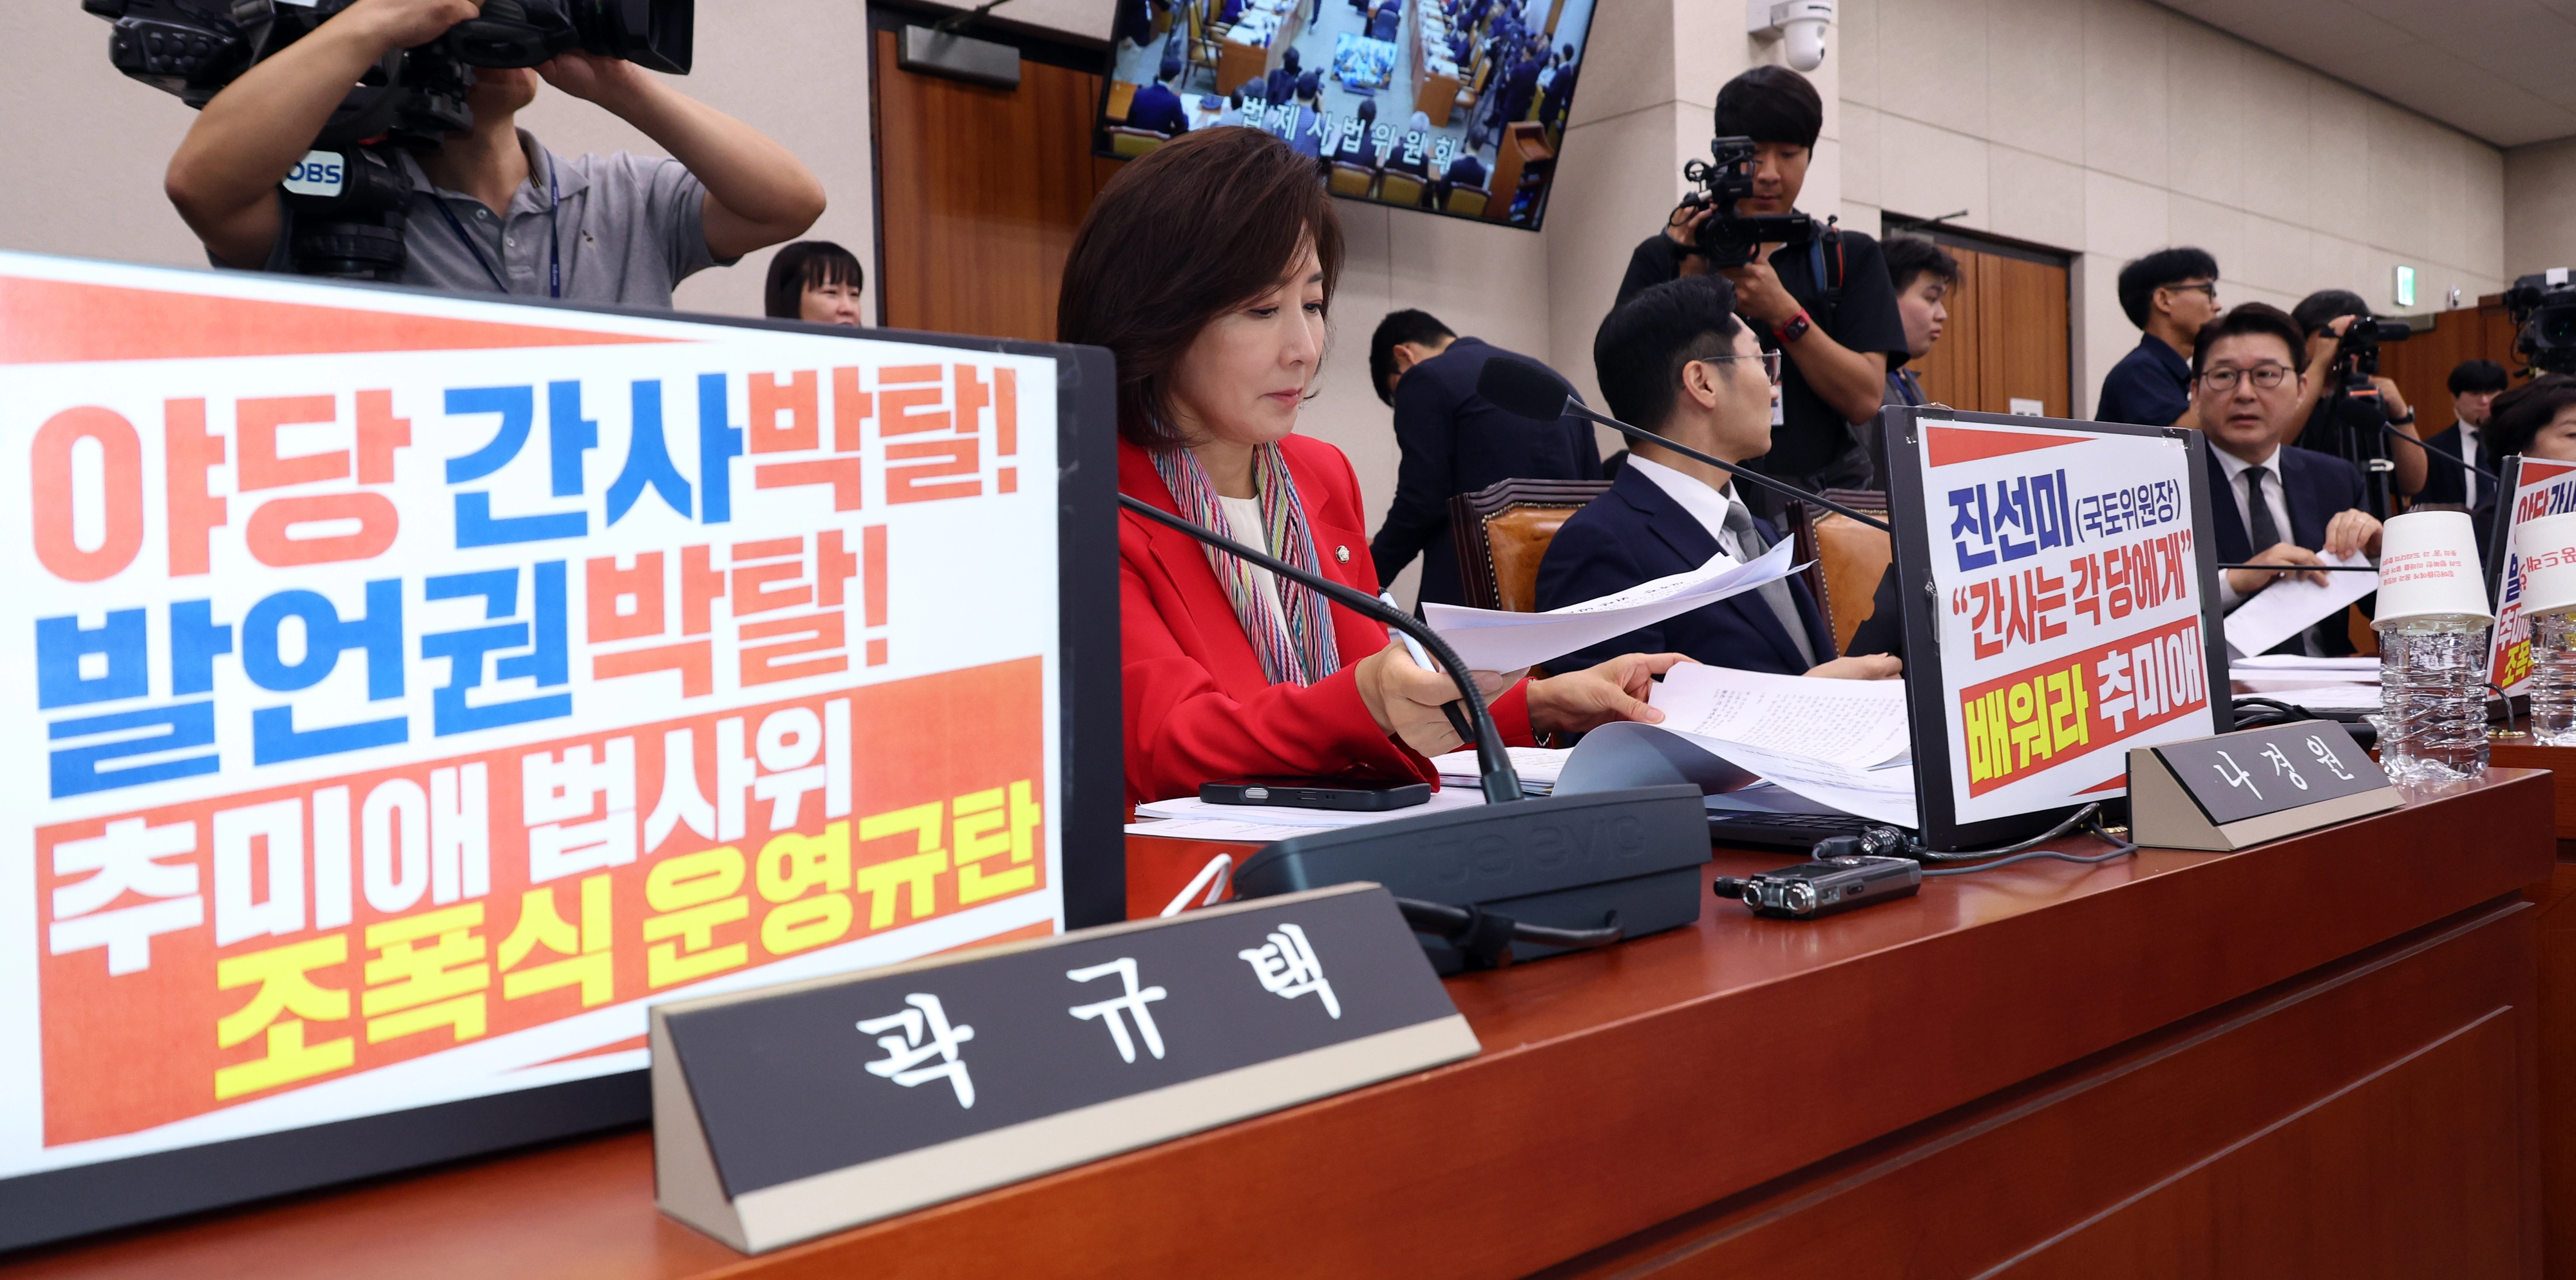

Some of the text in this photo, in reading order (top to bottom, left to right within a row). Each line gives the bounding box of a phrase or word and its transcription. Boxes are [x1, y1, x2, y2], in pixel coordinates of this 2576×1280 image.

[1242, 96, 1457, 170] 법제사법위원회
[30, 388, 412, 584] 야당
[1953, 529, 2191, 660] “간사는 각 당에게”
[2414, 571, 2454, 579] 장애인들에게
[2498, 608, 2530, 651] 추미
[1964, 663, 2088, 784] 배워라
[2098, 626, 2203, 732] 추미애
[2501, 640, 2535, 687] 조폭
[49, 698, 851, 976] 추미애 법사위
[214, 780, 1039, 1102] 조폭식 운영규탄
